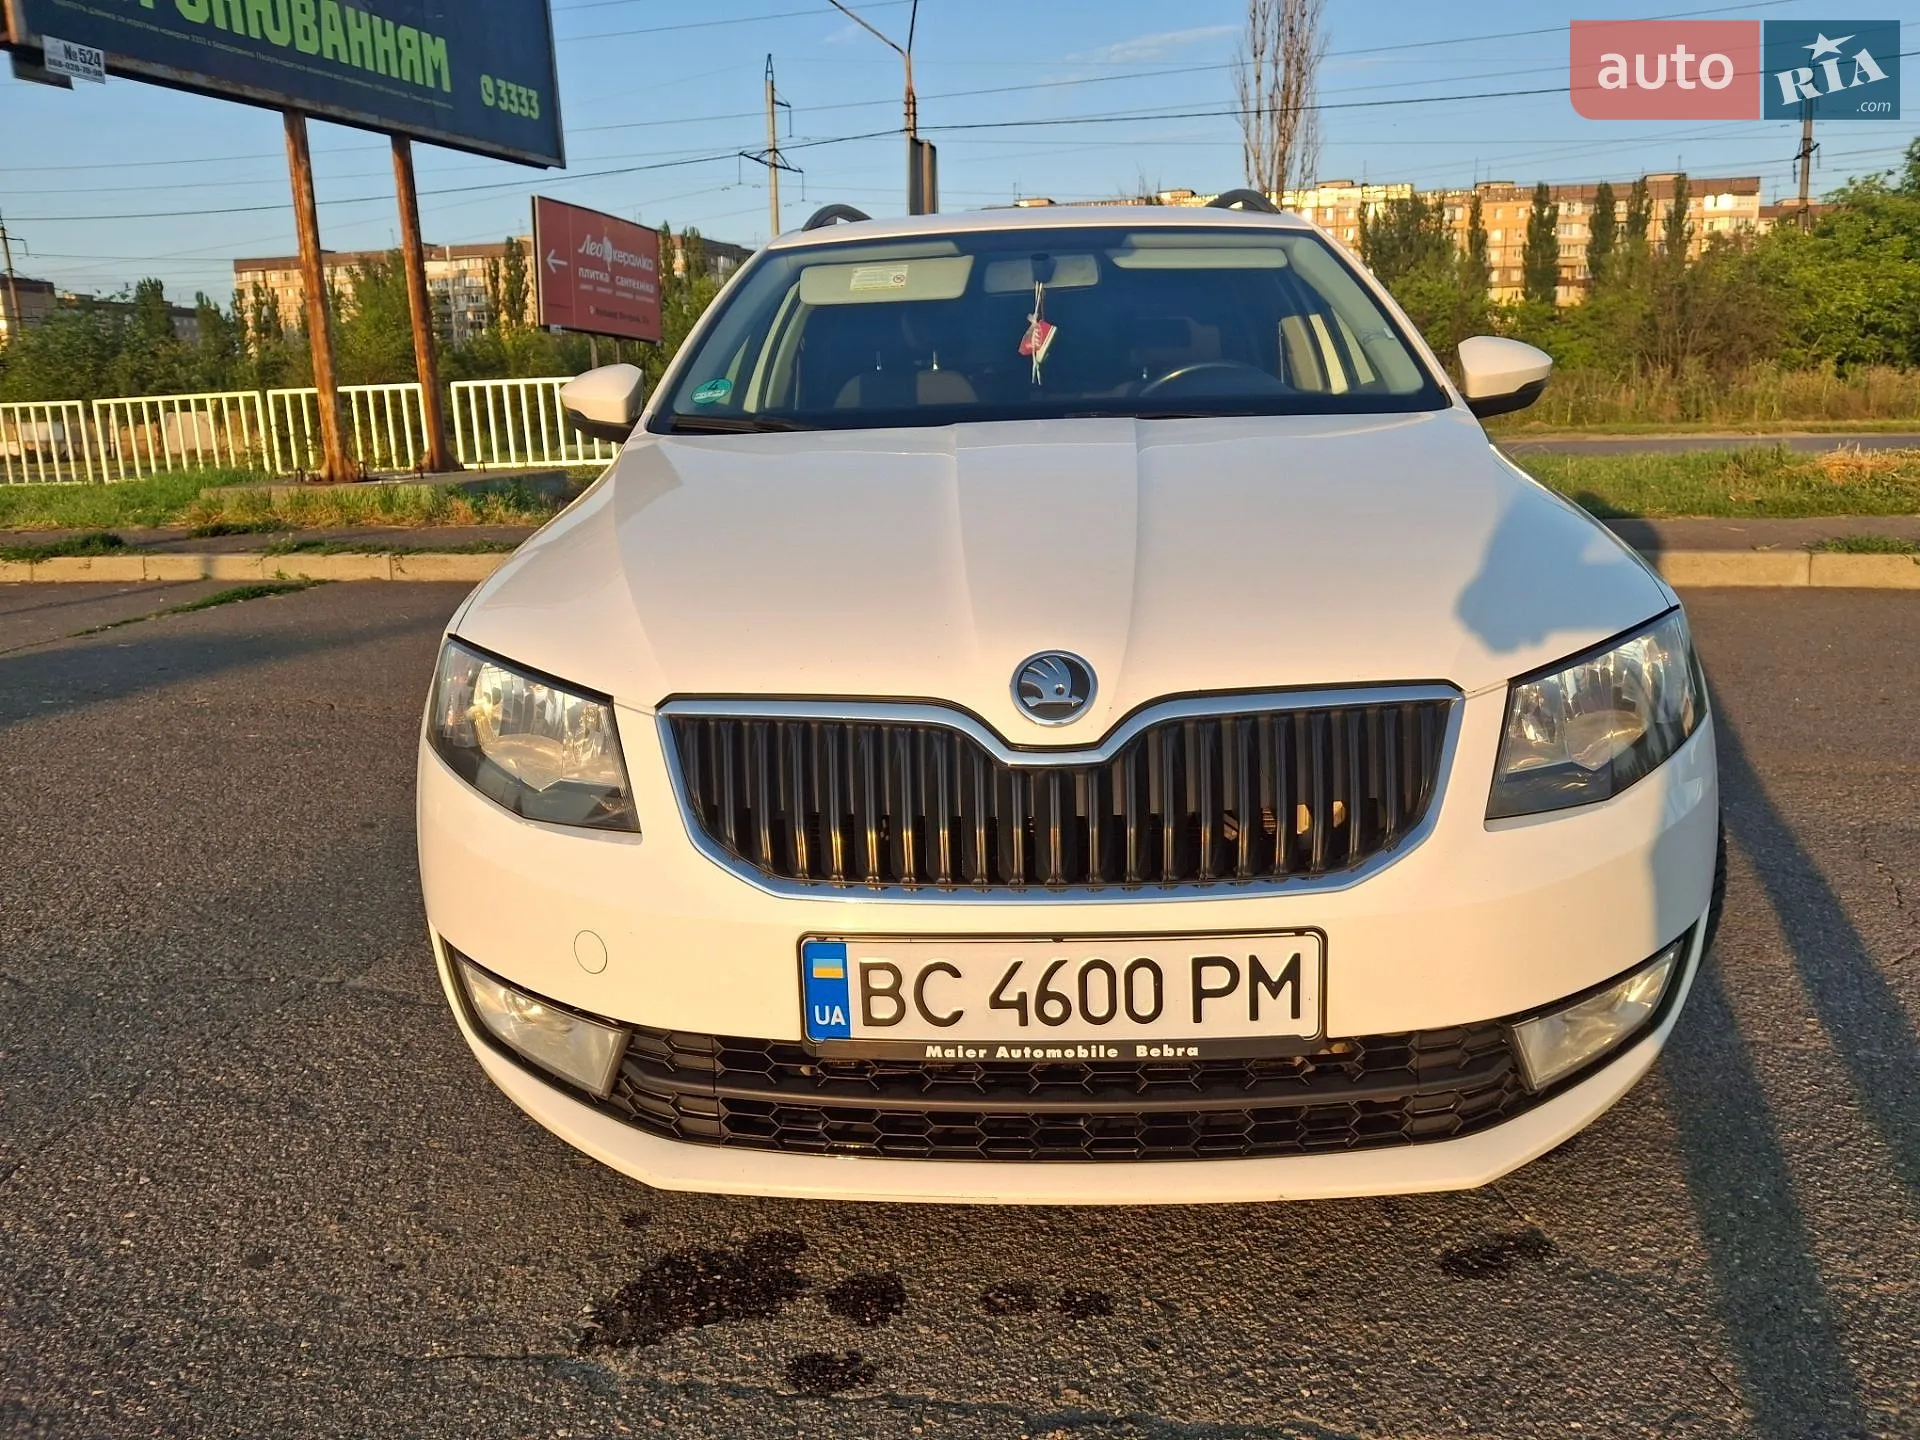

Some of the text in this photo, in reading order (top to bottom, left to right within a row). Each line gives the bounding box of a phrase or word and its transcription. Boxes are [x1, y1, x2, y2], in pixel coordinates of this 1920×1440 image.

[495, 78, 540, 120] 3333
[578, 267, 610, 283] плитка
[858, 952, 1301, 1027] BC 4600 PM
[814, 1005, 848, 1026] UA
[925, 1044, 1199, 1059] Maier Automobile Bebra
